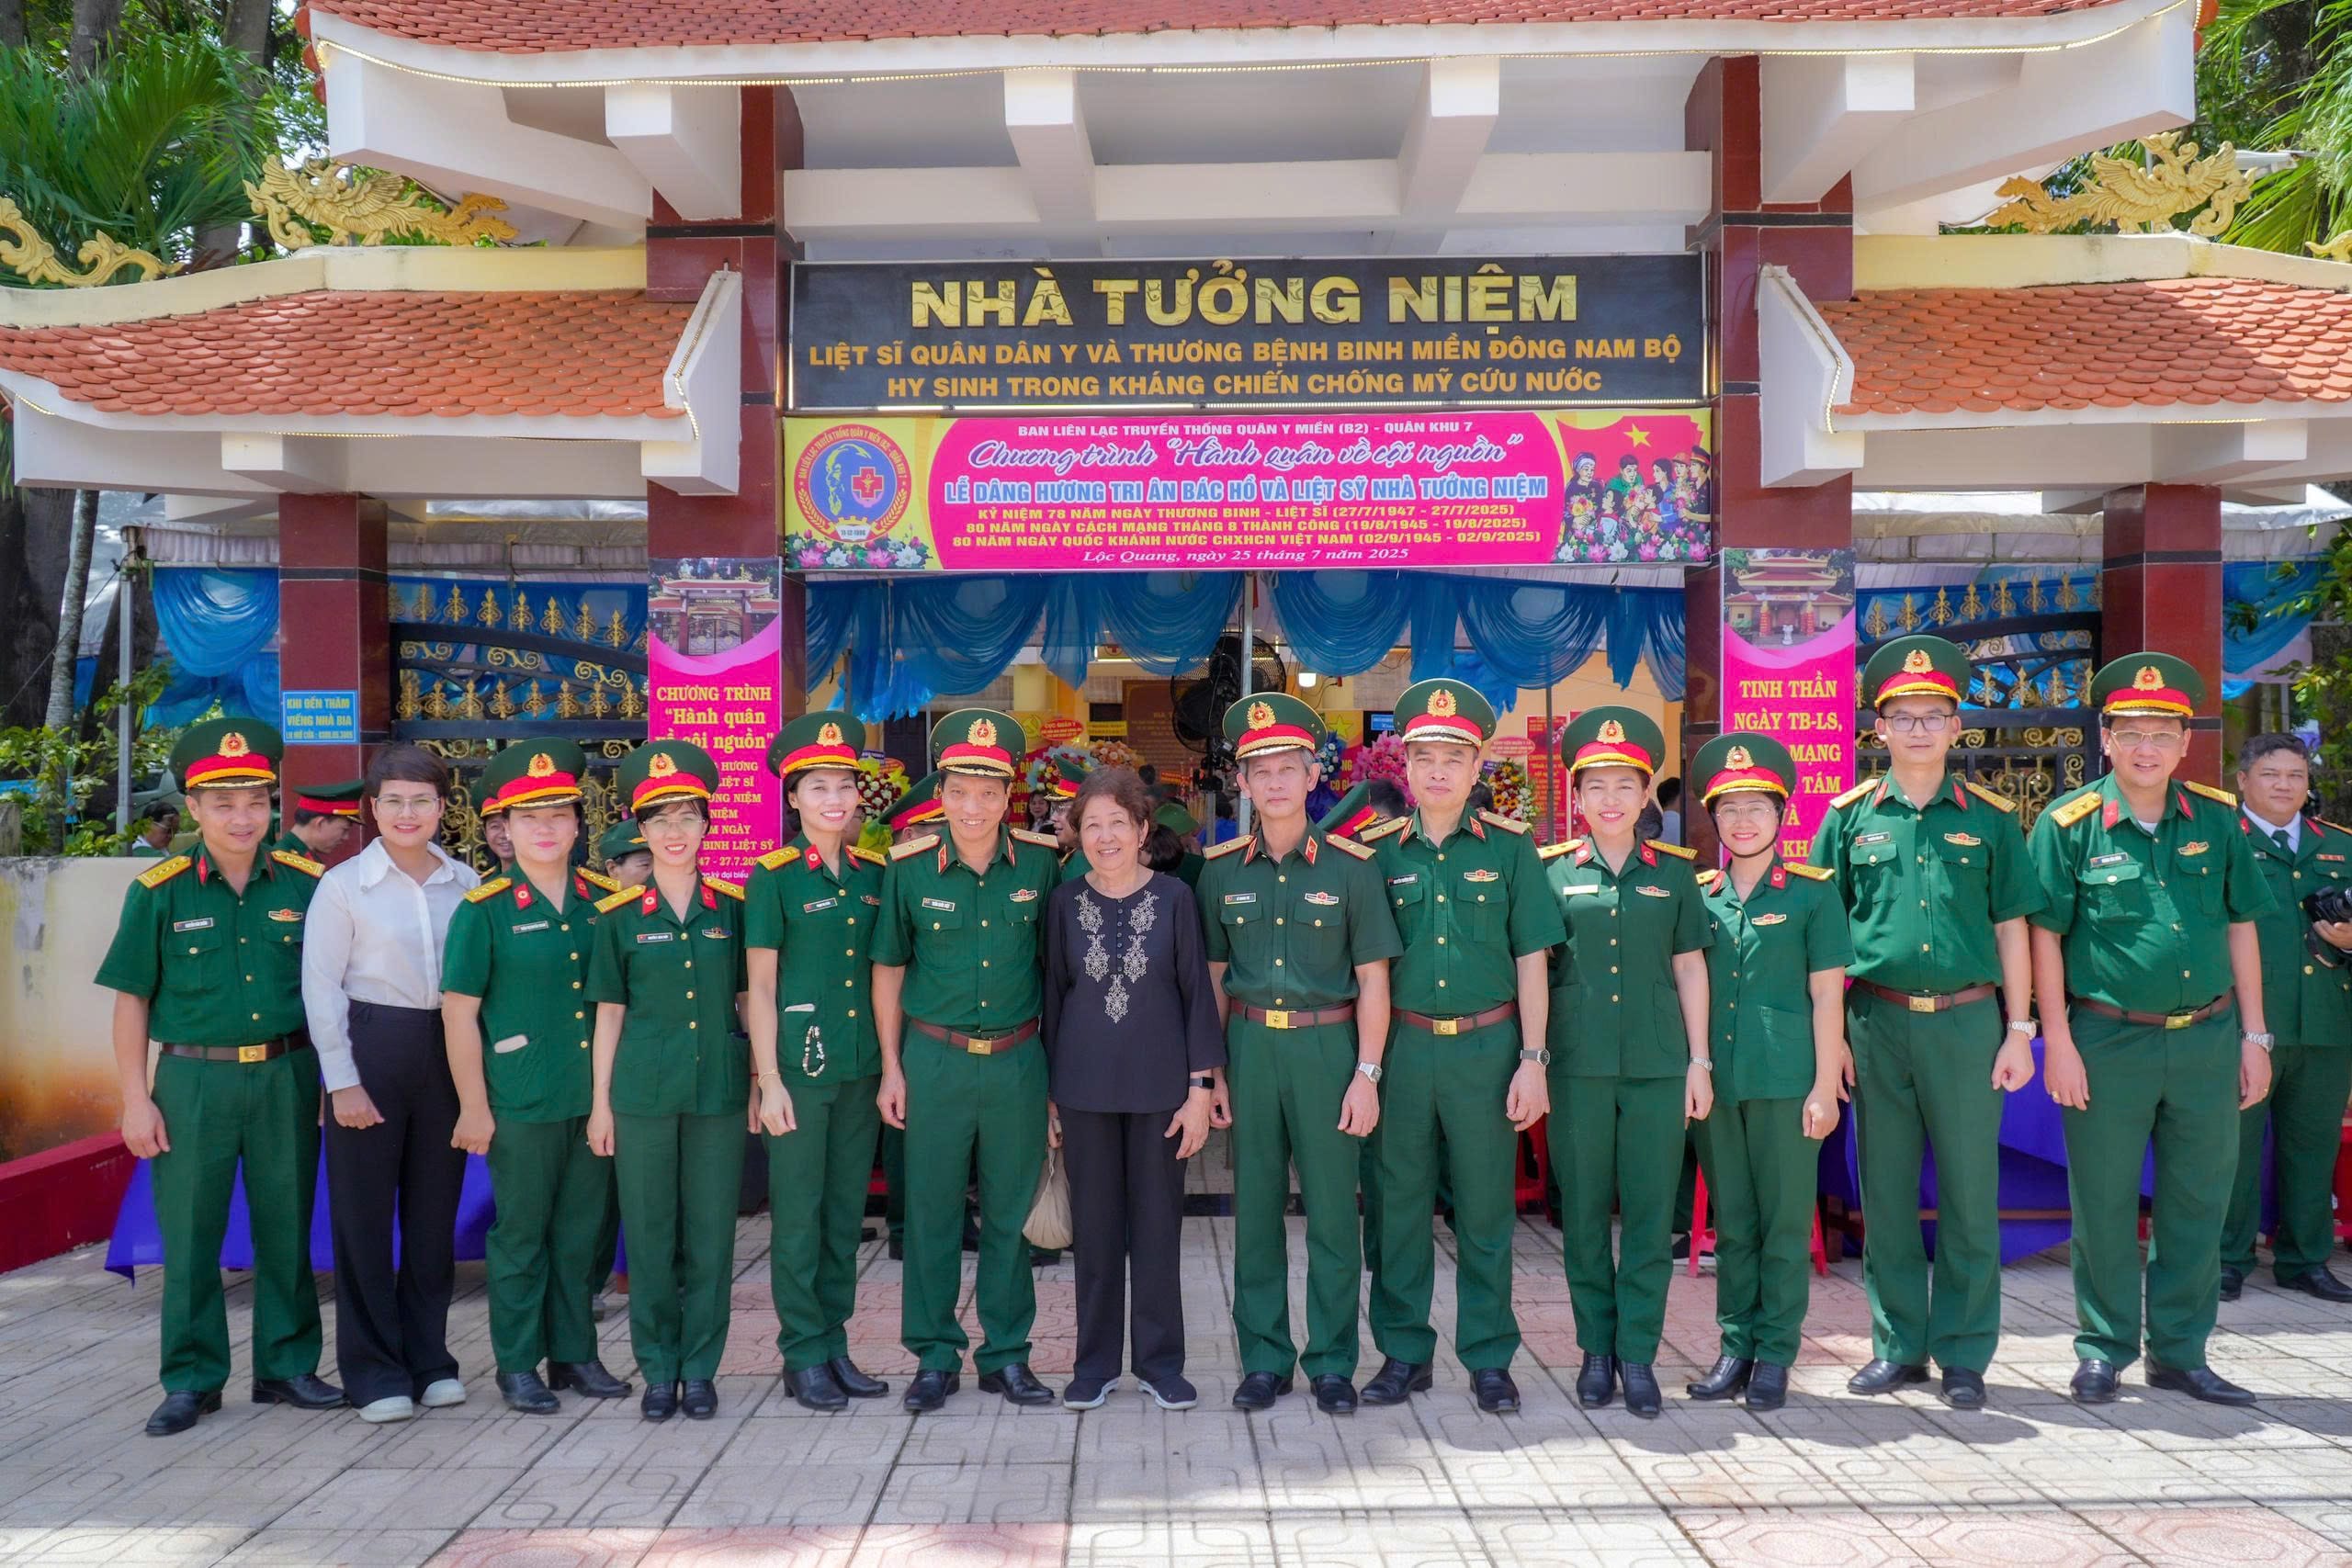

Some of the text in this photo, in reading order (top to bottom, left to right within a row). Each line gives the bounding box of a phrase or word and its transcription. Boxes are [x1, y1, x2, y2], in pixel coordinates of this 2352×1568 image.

[911, 259, 1577, 334] NHÀ TƯỞNG NIỆM
[809, 332, 1681, 370] LIỆT SĨ QUÂN DÂN Y VÀ THƯƠNG BỆNH BINH MIỀN ĐÔNG NAM BỘ
[888, 367, 1602, 398] HY SINH TRONG KHÁNG CHIẾN CHỐNG MỸ CỨU NƯỚC
[1018, 426, 1049, 436] BAN
[1053, 424, 1086, 436] LIÊN
[1091, 426, 1118, 438] LẠC
[1123, 423, 1179, 435] TRUYỀN
[1183, 423, 1231, 434] THỐNG
[1237, 423, 1277, 436] QUÂN
[1282, 424, 1291, 434] Y
[1295, 420, 1333, 434] MIỀN
[1339, 423, 1369, 434] (B2)
[1385, 423, 1425, 434] QUÂN
[1430, 422, 1459, 433] KHU
[1464, 422, 1473, 432] 7
[967, 439, 1076, 476] Chương
[1080, 442, 1157, 467] trình
[1264, 441, 1334, 471] quân
[1338, 436, 1369, 463] về
[1373, 441, 1416, 468] cội
[944, 470, 1547, 505] LỄ DÂNG HƯƠNG TRI ÂN BÁC HỒ VÀ LIỆT SỸ NHÀ TƯỞNG NIỆM
[1002, 507, 1043, 521] NIỆM
[1047, 509, 1066, 519] 78
[1070, 507, 1106, 519] NĂM
[1111, 506, 1153, 519] NGÀY
[1158, 507, 1218, 519] THƯƠNG
[1223, 507, 1261, 518] BINH
[1275, 505, 1307, 520] LIỆT
[1333, 505, 1416, 518] (27/7/1947
[1430, 503, 1515, 516] 27/7/2025)
[967, 523, 985, 533] 80
[989, 521, 1025, 532] NĂM
[1030, 521, 1071, 533] NGÀY
[1076, 520, 1117, 532] CÁCH
[1122, 522, 1168, 534] MẠNG
[1172, 520, 1224, 532] THÁNG
[1227, 521, 1238, 532] 8
[1242, 519, 1293, 531] THÀNH
[1297, 519, 1340, 530] CÔNG
[1344, 518, 1428, 531] (19/8/1945
[1443, 517, 1527, 529] 19/8/2025)
[953, 536, 971, 547] 80
[976, 535, 1012, 547] NĂM
[1016, 535, 1057, 547] NGÀY
[1062, 533, 1103, 547] QUỐC
[1108, 533, 1161, 546] KHÁNH
[1166, 533, 1208, 546] NƯỚC
[1213, 534, 1276, 545] CHXHCN
[1281, 532, 1314, 547] VIỆT
[1317, 534, 1354, 544] NAM
[1359, 532, 1442, 545] (02/9/1945
[1457, 530, 1542, 543] 02/9/2025)
[1082, 548, 1409, 563] Lộc Quang, ngày 25 tháng 7 năm 2025
[657, 683, 772, 701] CHƯƠNG TRÌNH
[1739, 670, 1838, 698] TINH THẦN
[724, 708, 765, 728] quân
[1734, 708, 1842, 731] NGÀY TB-LS,
[1790, 744, 1841, 766] MẠNG
[721, 761, 758, 771] HƯƠNG
[718, 775, 741, 788] IỆT
[1803, 772, 1841, 794] TÁM
[734, 791, 762, 804] NIỆM
[710, 807, 738, 820] NIỆM
[722, 823, 751, 834] NGÀY
[703, 840, 729, 850] BINH
[732, 840, 757, 852] LIỆT
[719, 857, 758, 866] 27.7.202
